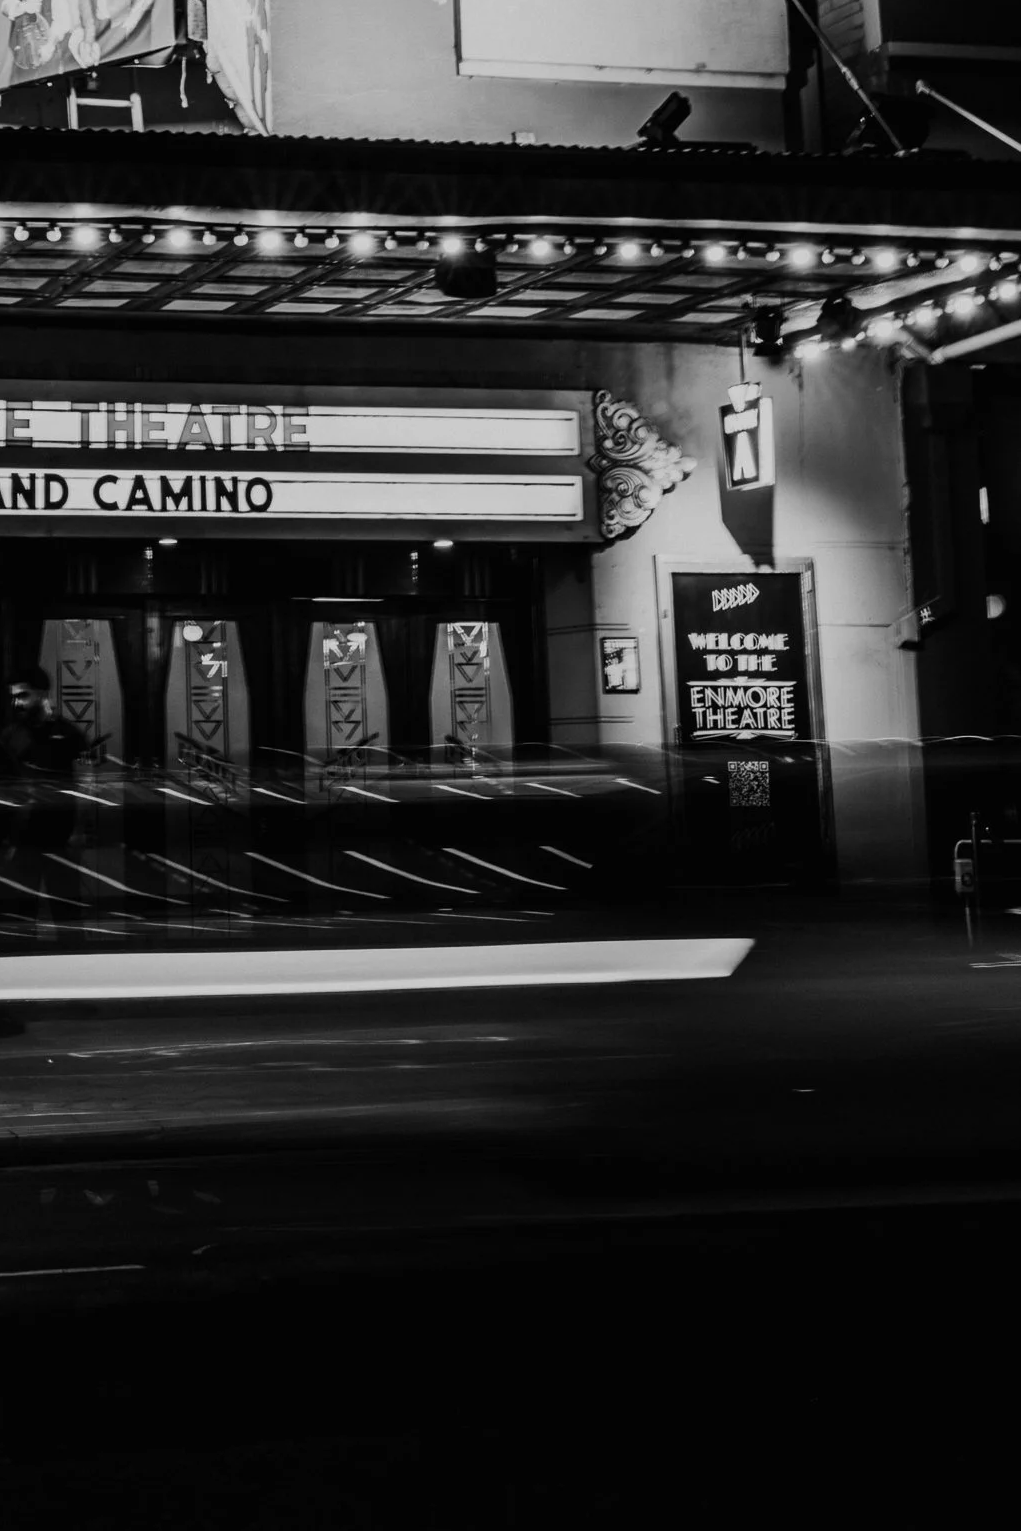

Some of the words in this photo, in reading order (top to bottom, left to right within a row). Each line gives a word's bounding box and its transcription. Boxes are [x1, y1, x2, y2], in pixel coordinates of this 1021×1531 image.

[71, 401, 311, 451] THEATRE
[92, 474, 273, 512] CAMINO
[688, 633, 790, 650] WELCOME
[703, 654, 733, 671] TO
[734, 654, 778, 671] THE
[690, 686, 795, 708] ENMORE
[691, 707, 795, 729] THEATRE
